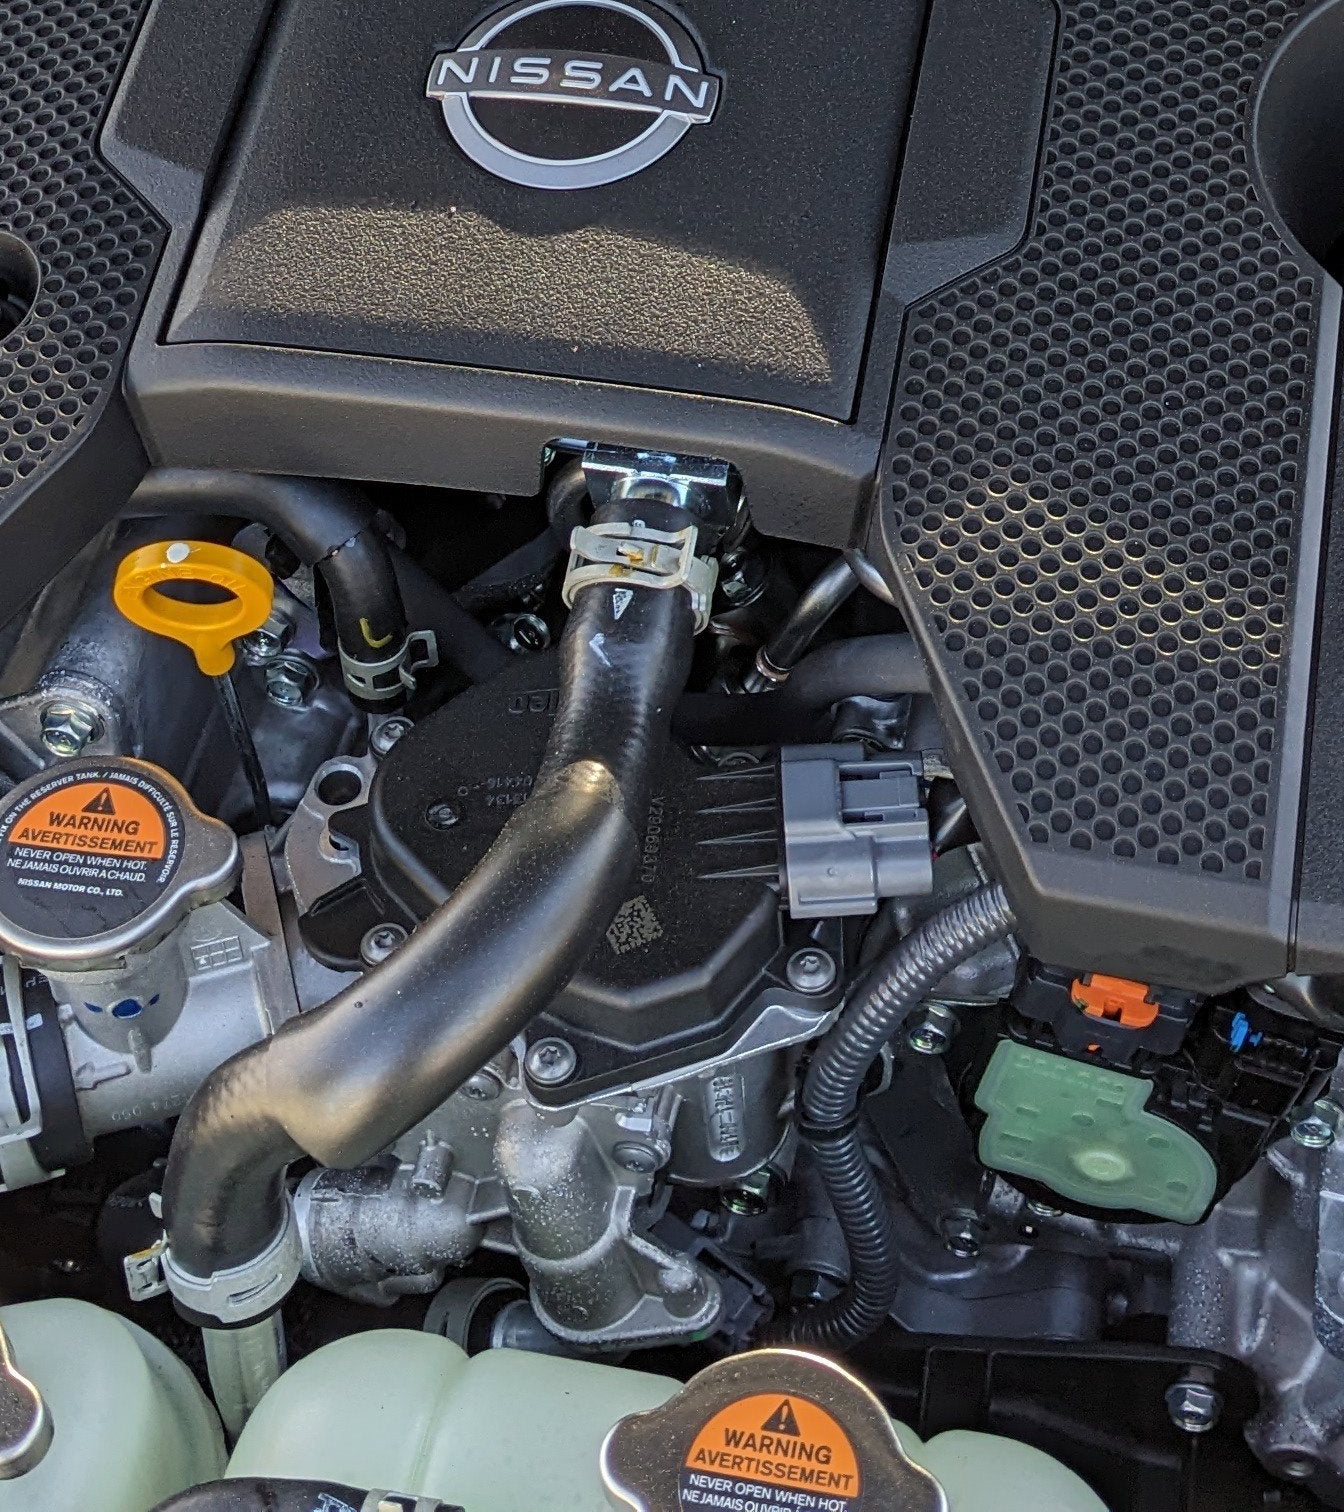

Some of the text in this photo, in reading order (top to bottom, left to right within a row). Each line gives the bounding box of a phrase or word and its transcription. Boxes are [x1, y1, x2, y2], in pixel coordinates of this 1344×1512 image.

[437, 56, 709, 108] NISSAN
[109, 772, 138, 785] JAMAIS
[15, 797, 31, 812] THE
[5, 811, 17, 824] ON
[48, 811, 140, 835] WARNING
[167, 811, 177, 828] SUR
[17, 827, 158, 853] AVERTISSEMENT
[171, 828, 179, 838] LE
[7, 858, 22, 868] NE
[22, 860, 58, 873] JAMAIS
[60, 865, 98, 876] OUVRIR
[107, 870, 146, 882] CHAUD.
[15, 847, 147, 871] NEVER OPEN WHEN HOT.
[17, 877, 51, 888] NISSAN
[53, 882, 86, 893] MOTOR
[106, 888, 124, 897] LTD.
[724, 1428, 832, 1465] WARNING
[693, 1447, 854, 1491] AVERTISSEMENT
[682, 1489, 701, 1503] NE
[700, 1493, 743, 1510] JAMAIS
[689, 1474, 732, 1492] NEVER
[734, 1483, 772, 1499] OPEN
[775, 1490, 817, 1507] WHEN
